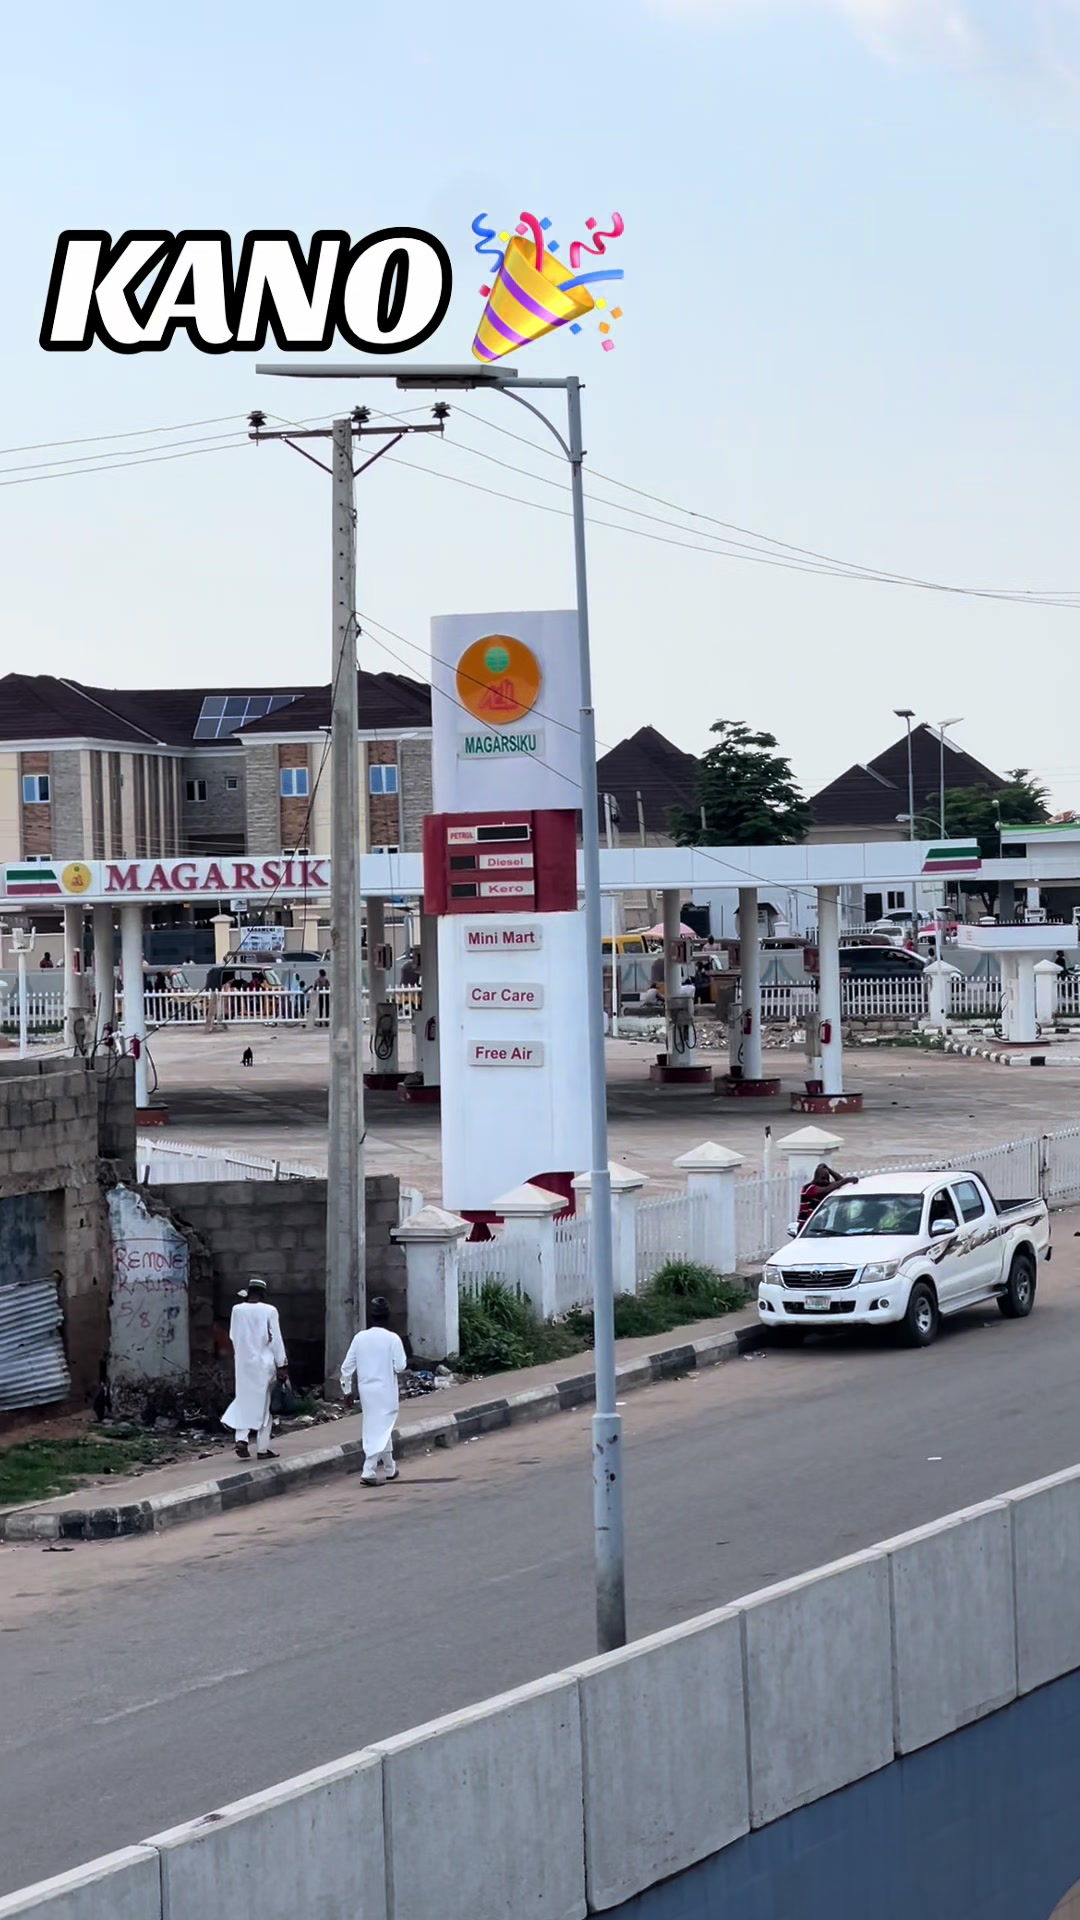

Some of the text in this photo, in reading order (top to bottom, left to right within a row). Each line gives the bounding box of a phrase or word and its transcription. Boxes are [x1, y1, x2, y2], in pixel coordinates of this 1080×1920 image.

[465, 734, 537, 753] MAGARSIKU
[487, 857, 524, 867] Diesel
[104, 858, 331, 893] MAGARSIK
[488, 884, 524, 894] Kero
[468, 931, 535, 945] Mini Mart
[471, 988, 535, 1002] Car Care
[475, 1046, 533, 1060] Free Air
[114, 1247, 188, 1272] REMOVE
